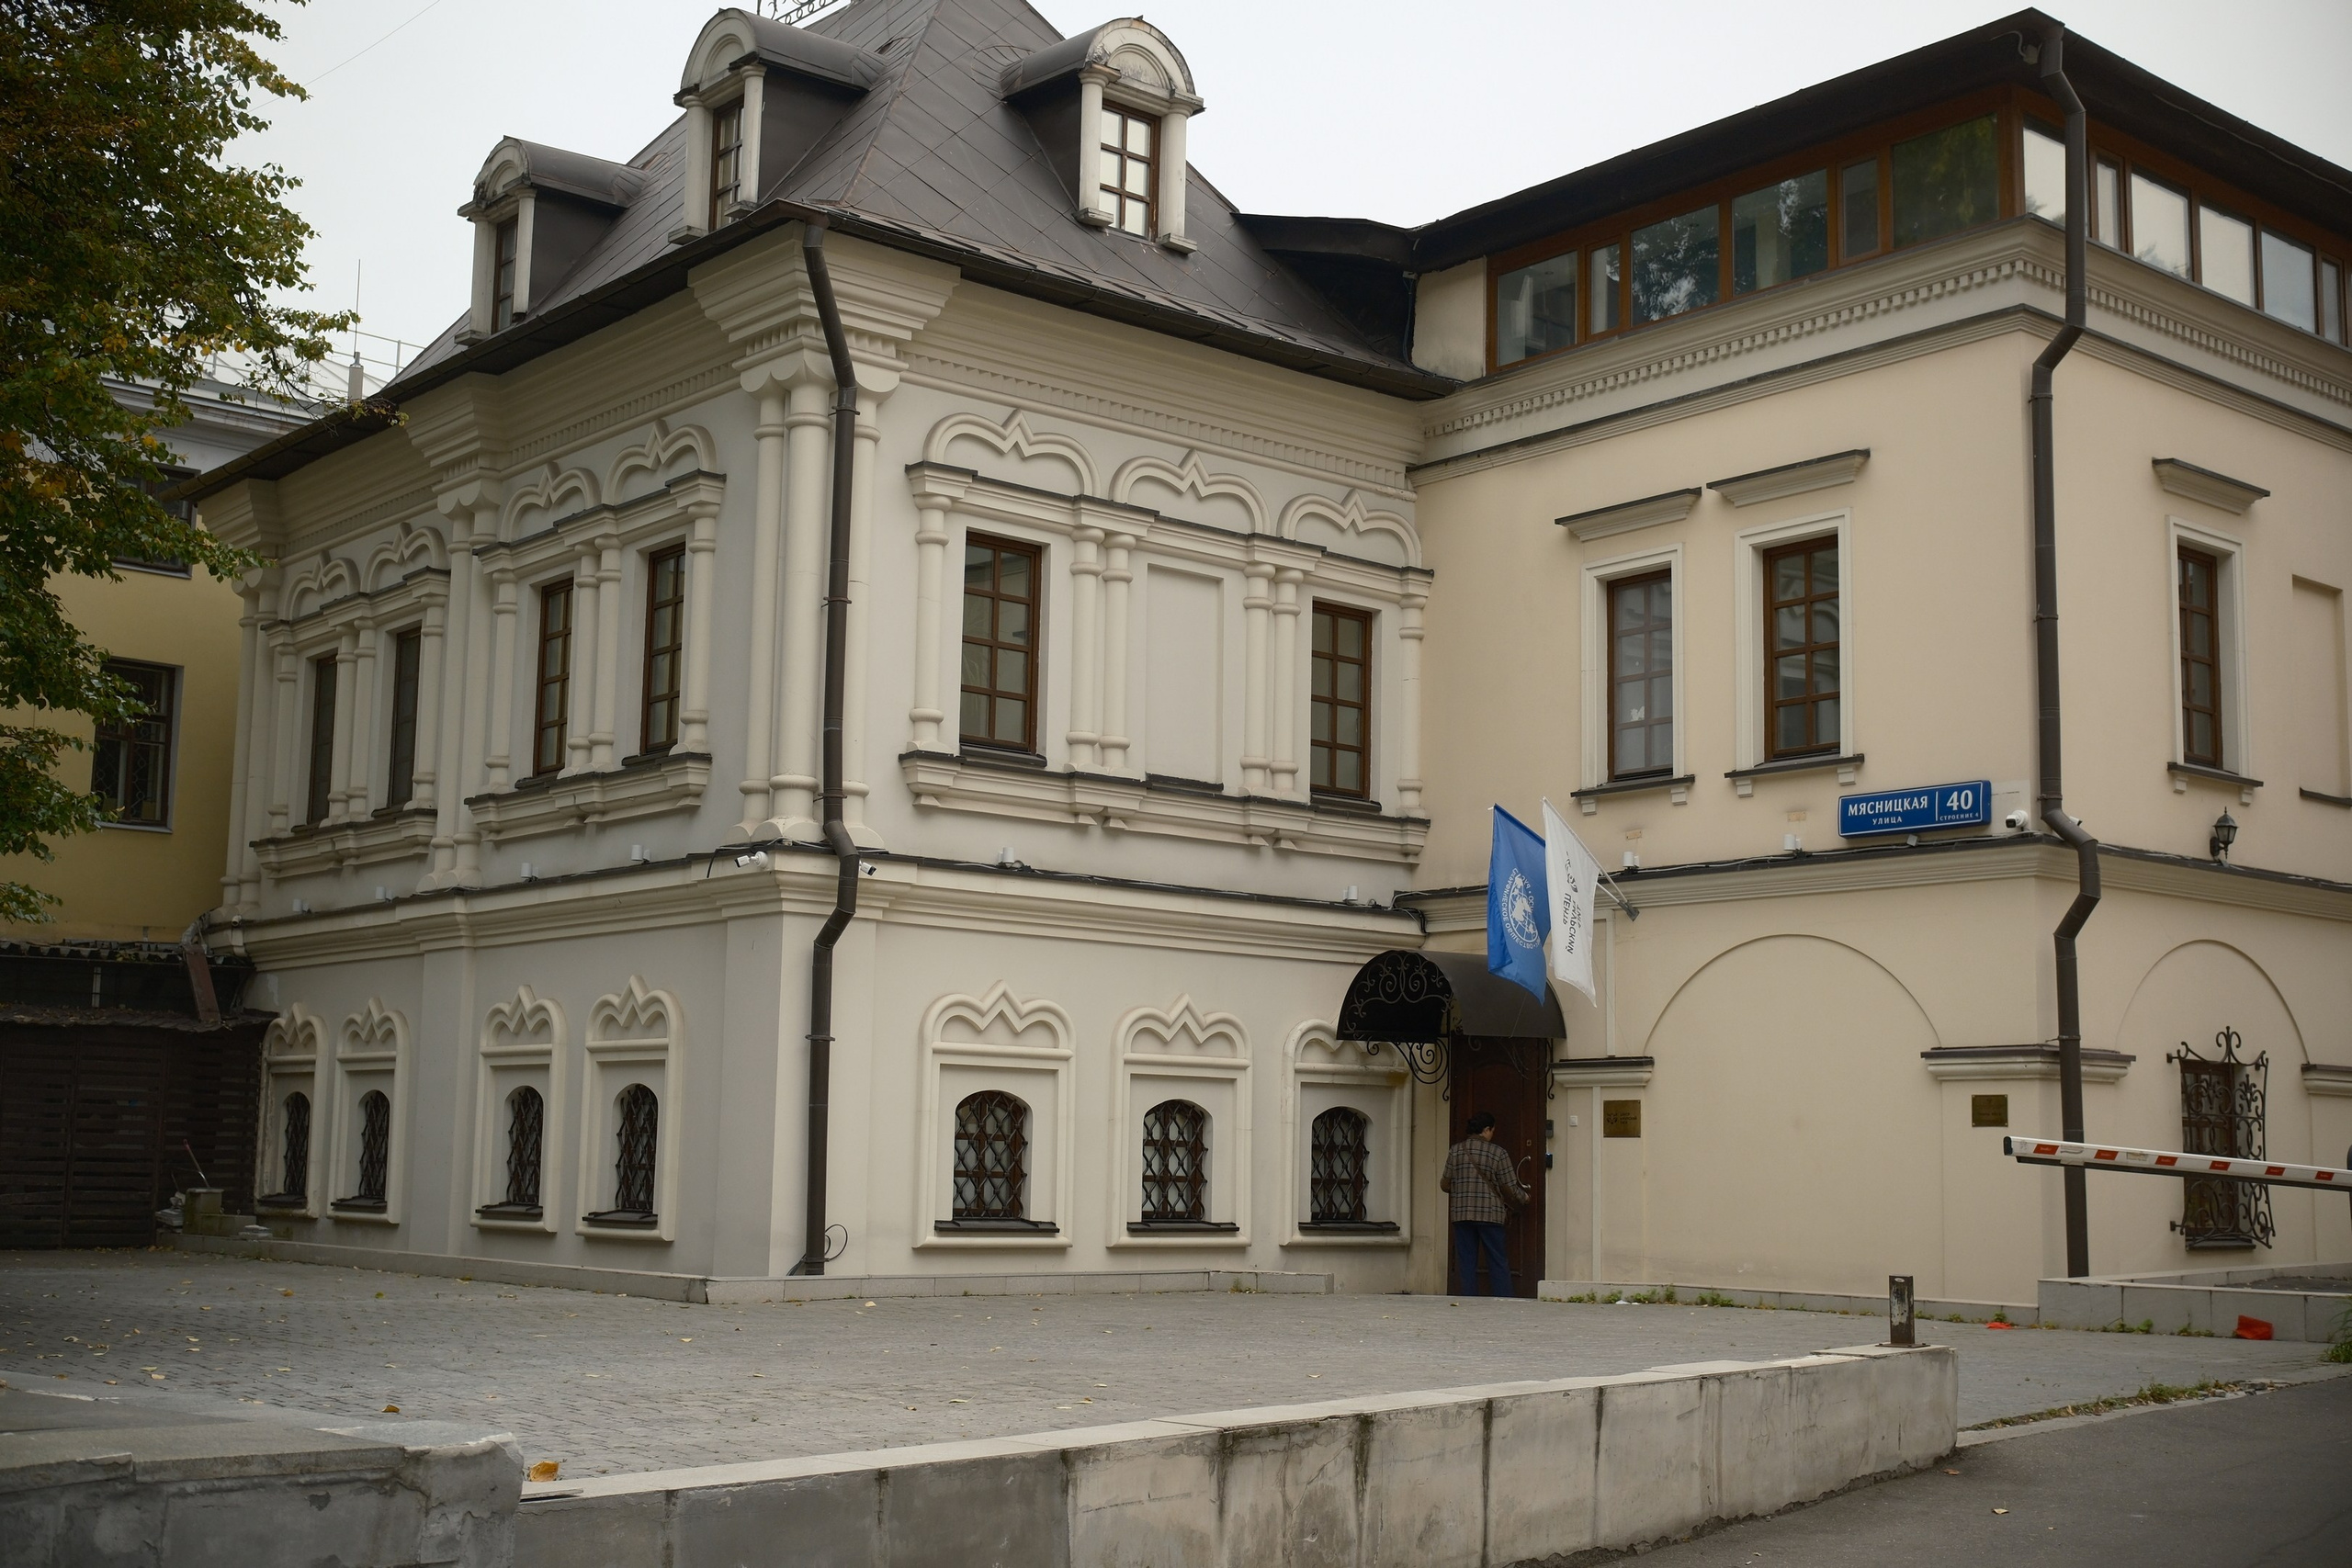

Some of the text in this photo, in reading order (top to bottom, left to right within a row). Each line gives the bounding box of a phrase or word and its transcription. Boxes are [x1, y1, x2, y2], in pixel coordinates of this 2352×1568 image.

[1849, 795, 1928, 816] МЯСНИЦКАЯ
[1946, 790, 1973, 811] 40
[1872, 817, 1903, 826] УЛИЦА
[1939, 812, 1973, 821] СТРОЕНИЕ
